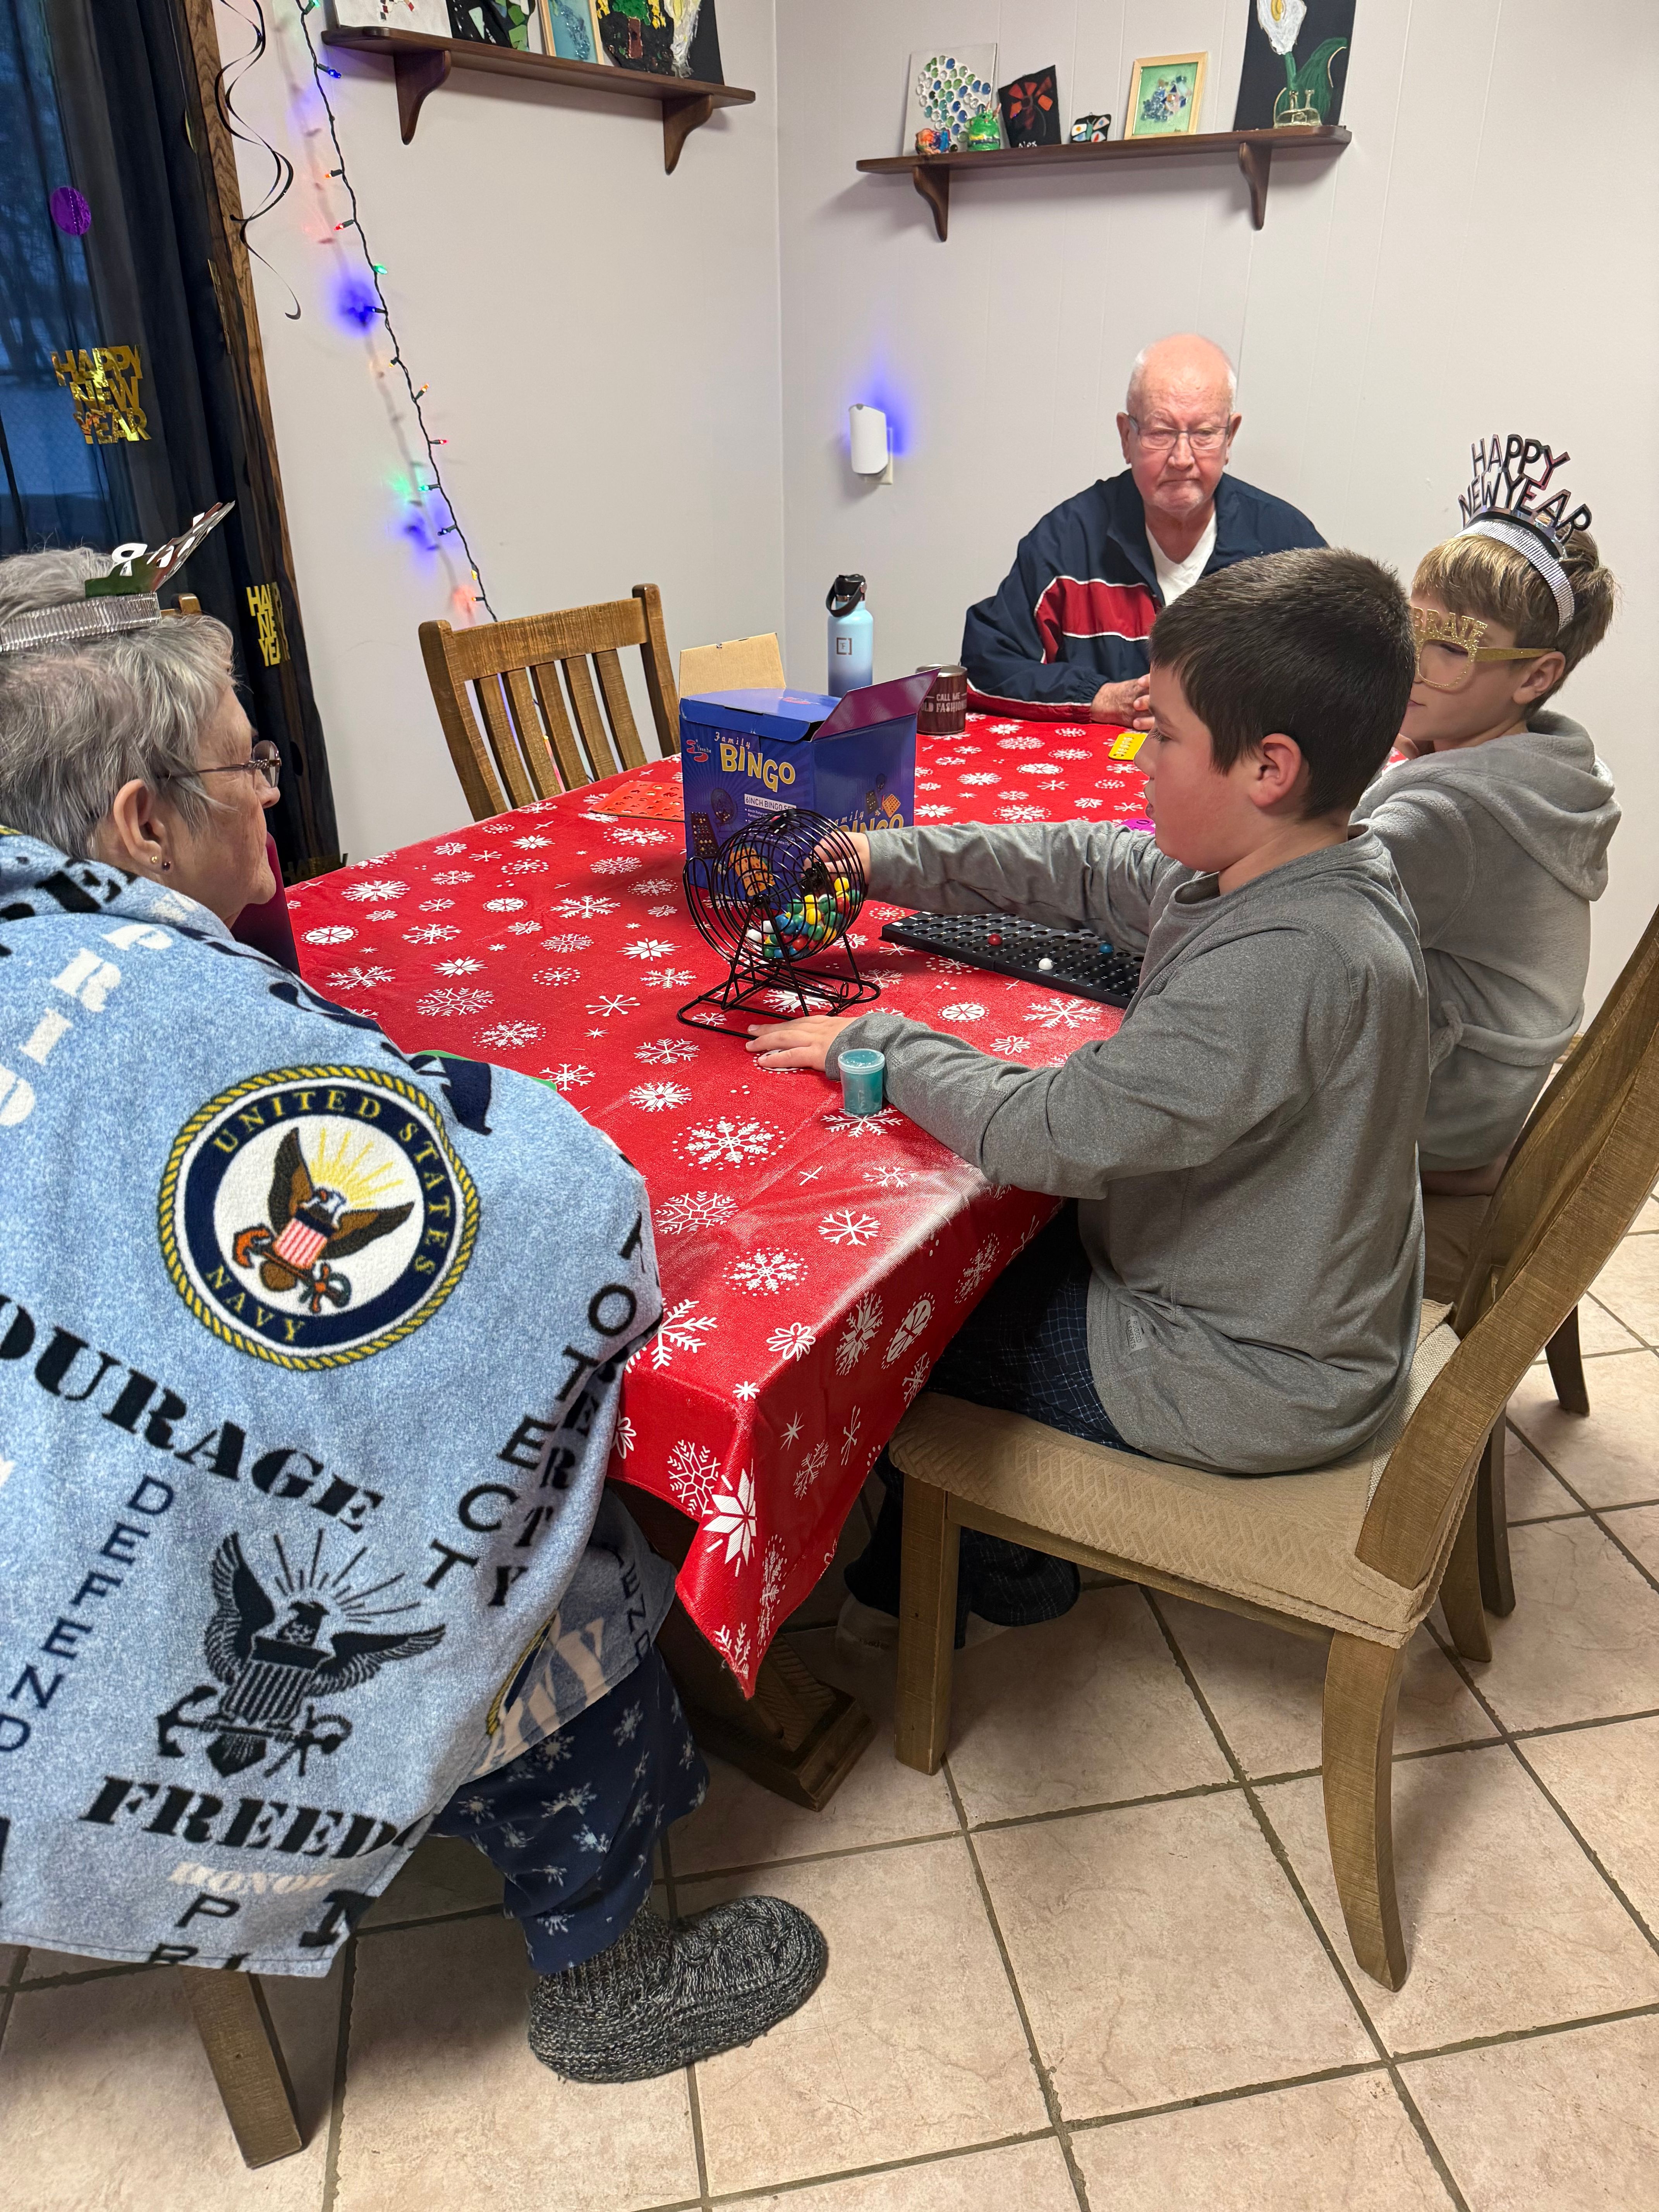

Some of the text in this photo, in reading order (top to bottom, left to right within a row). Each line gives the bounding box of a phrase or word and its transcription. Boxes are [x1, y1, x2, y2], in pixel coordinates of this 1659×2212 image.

[50, 345, 143, 386] HAPPY
[70, 376, 139, 417] NEW
[73, 407, 152, 444] YEAR
[1471, 434, 1571, 490] HAPPY
[1458, 470, 1592, 543] NEW YEAR
[1410, 606, 1488, 642] BRATE
[952, 692, 960, 701] ME
[720, 743, 795, 792] BINGO
[746, 797, 763, 807] 6INCH
[764, 801, 783, 811] BINGO
[834, 810, 864, 825] amily
[213, 1090, 451, 1275] UNITED STATES
[205, 1266, 305, 1341] NAVY
[1132, 1321, 1142, 1343] RUGGED
